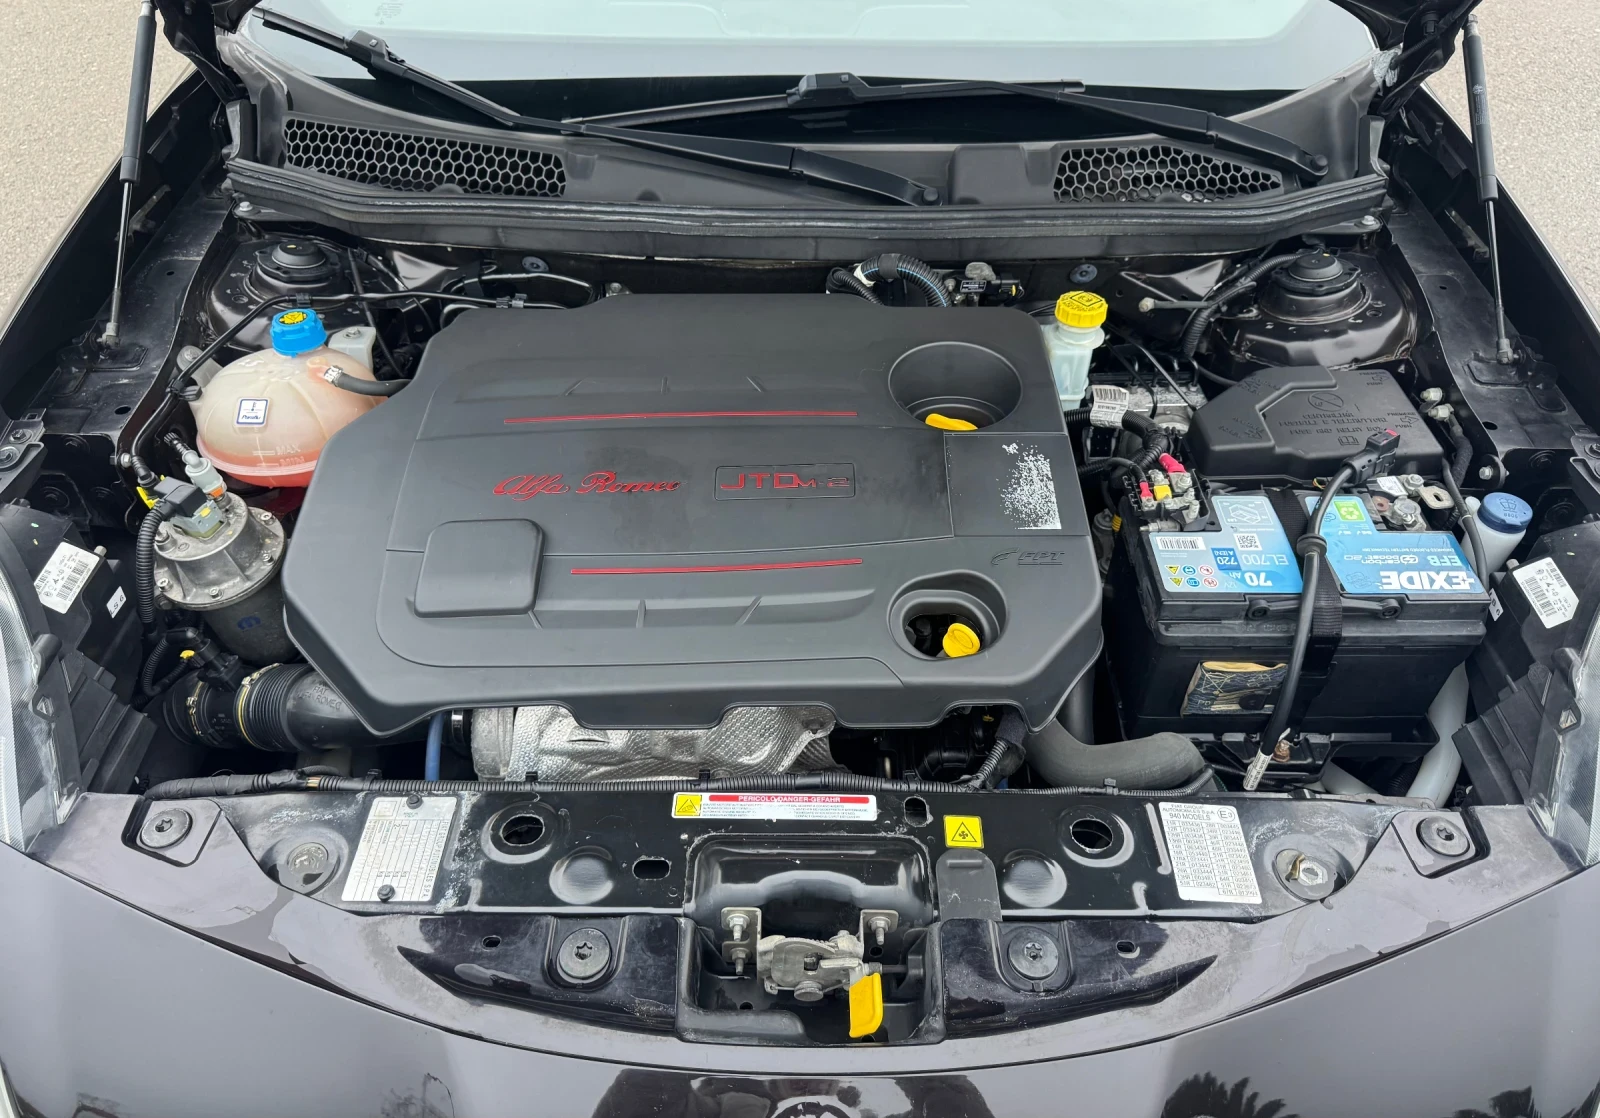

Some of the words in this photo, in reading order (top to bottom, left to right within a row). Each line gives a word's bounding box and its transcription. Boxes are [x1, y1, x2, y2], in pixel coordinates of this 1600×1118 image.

[275, 443, 301, 456] MAX
[493, 473, 571, 501] Alfa
[575, 470, 683, 494] Romeo
[1018, 551, 1066, 561] FPT
[1216, 556, 1237, 564] 720
[1241, 554, 1288, 564] EL700
[1426, 555, 1462, 566] EFB
[1243, 571, 1272, 585] 70
[1379, 570, 1475, 589] EXIDE
